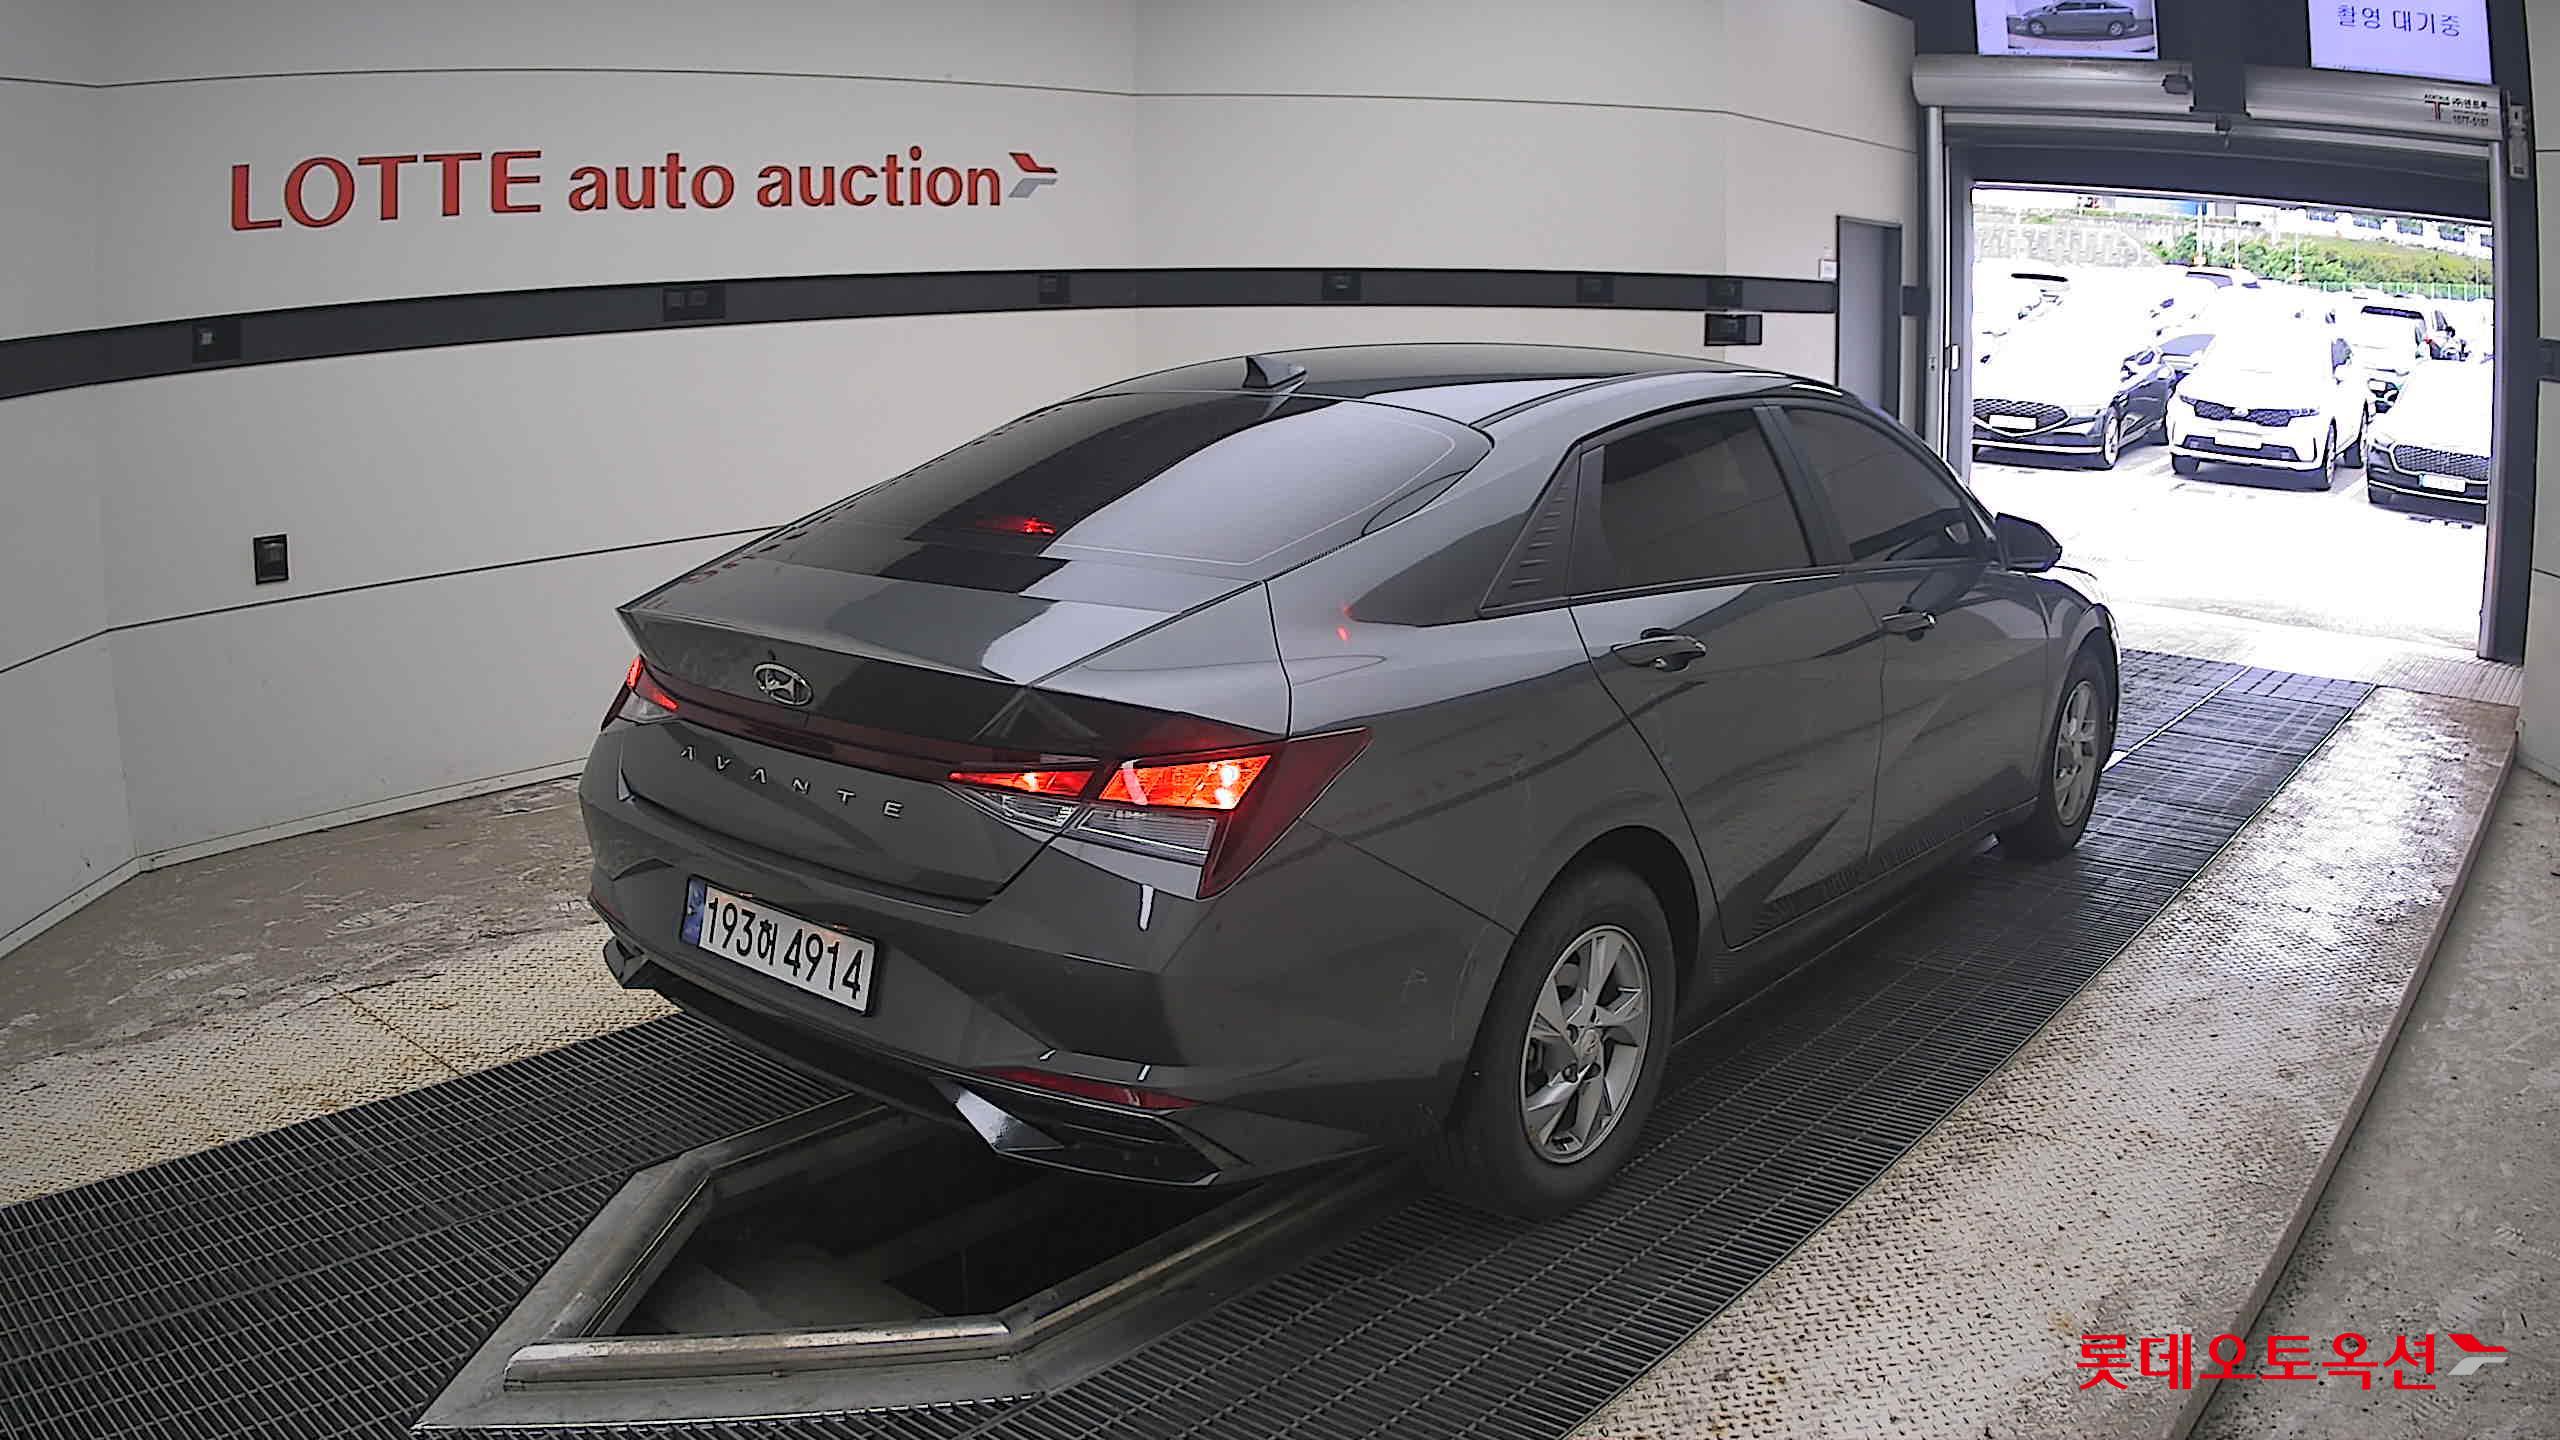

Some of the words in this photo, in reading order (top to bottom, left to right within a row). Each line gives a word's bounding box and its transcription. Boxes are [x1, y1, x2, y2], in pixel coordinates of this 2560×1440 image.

[2338, 4, 2381, 31] 촬영
[2392, 9, 2461, 38] 대기중
[230, 149, 542, 232] LOTTE
[567, 152, 735, 210] auto
[756, 145, 1002, 208] auction
[680, 745, 904, 818] AVANTE
